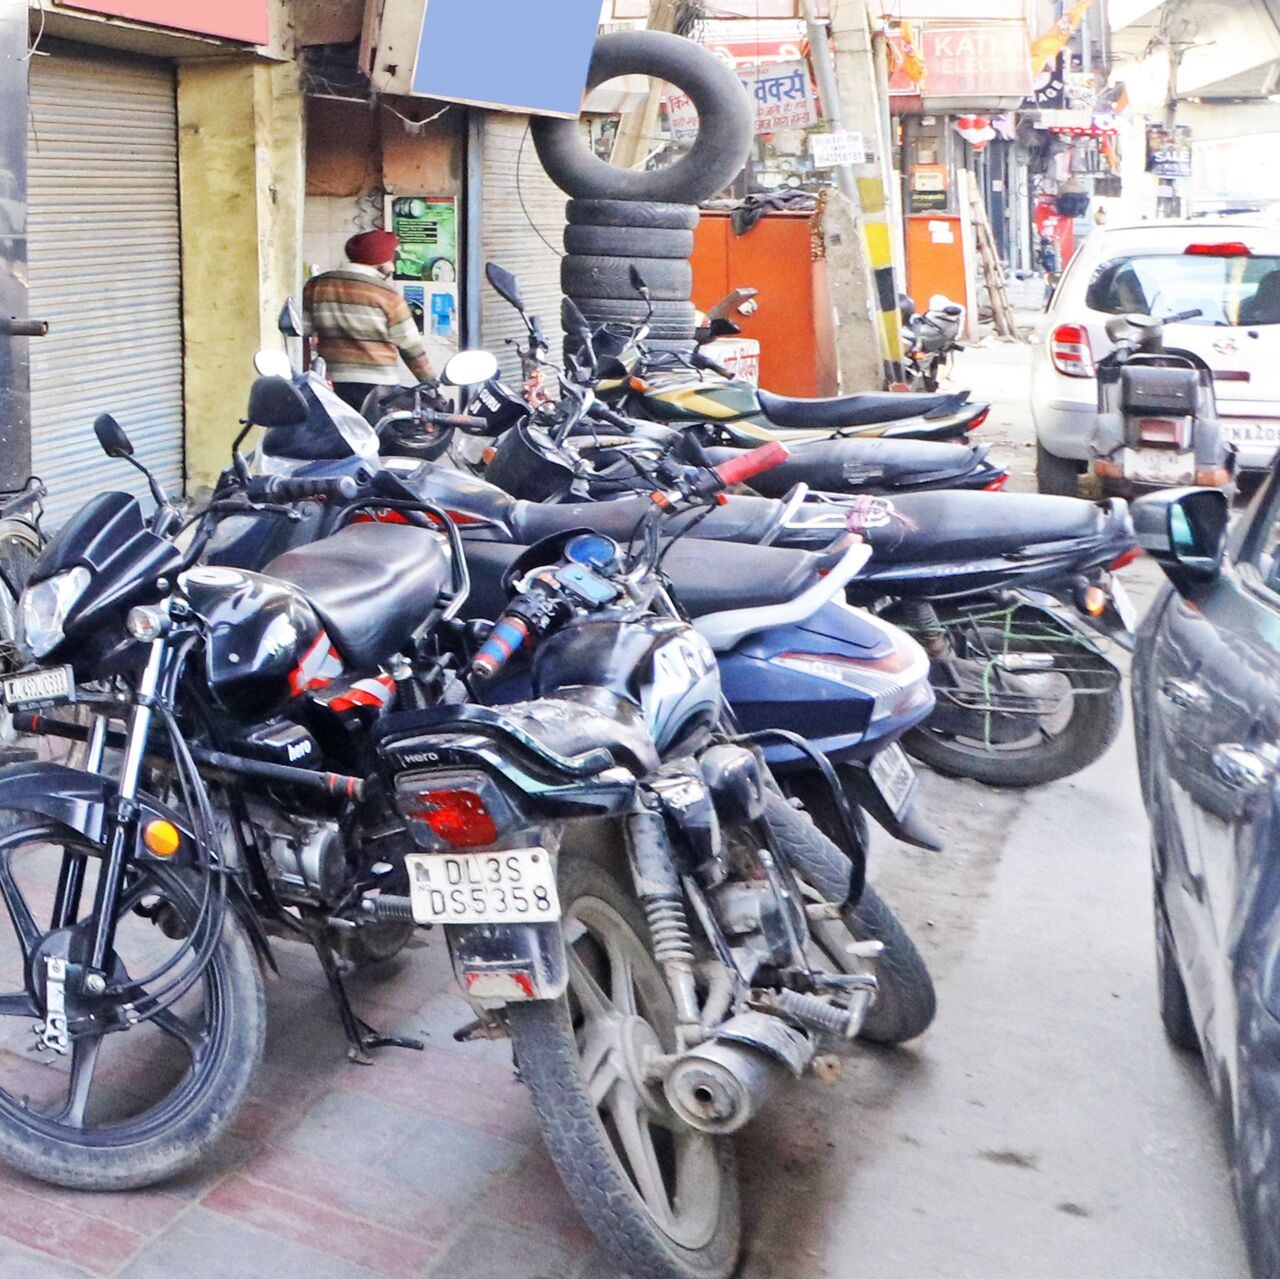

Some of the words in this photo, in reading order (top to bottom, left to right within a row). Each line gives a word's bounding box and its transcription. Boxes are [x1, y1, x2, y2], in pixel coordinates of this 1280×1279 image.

[1154, 151, 1190, 163] SALE
[479, 388, 501, 413] GURU
[287, 739, 312, 762] hero
